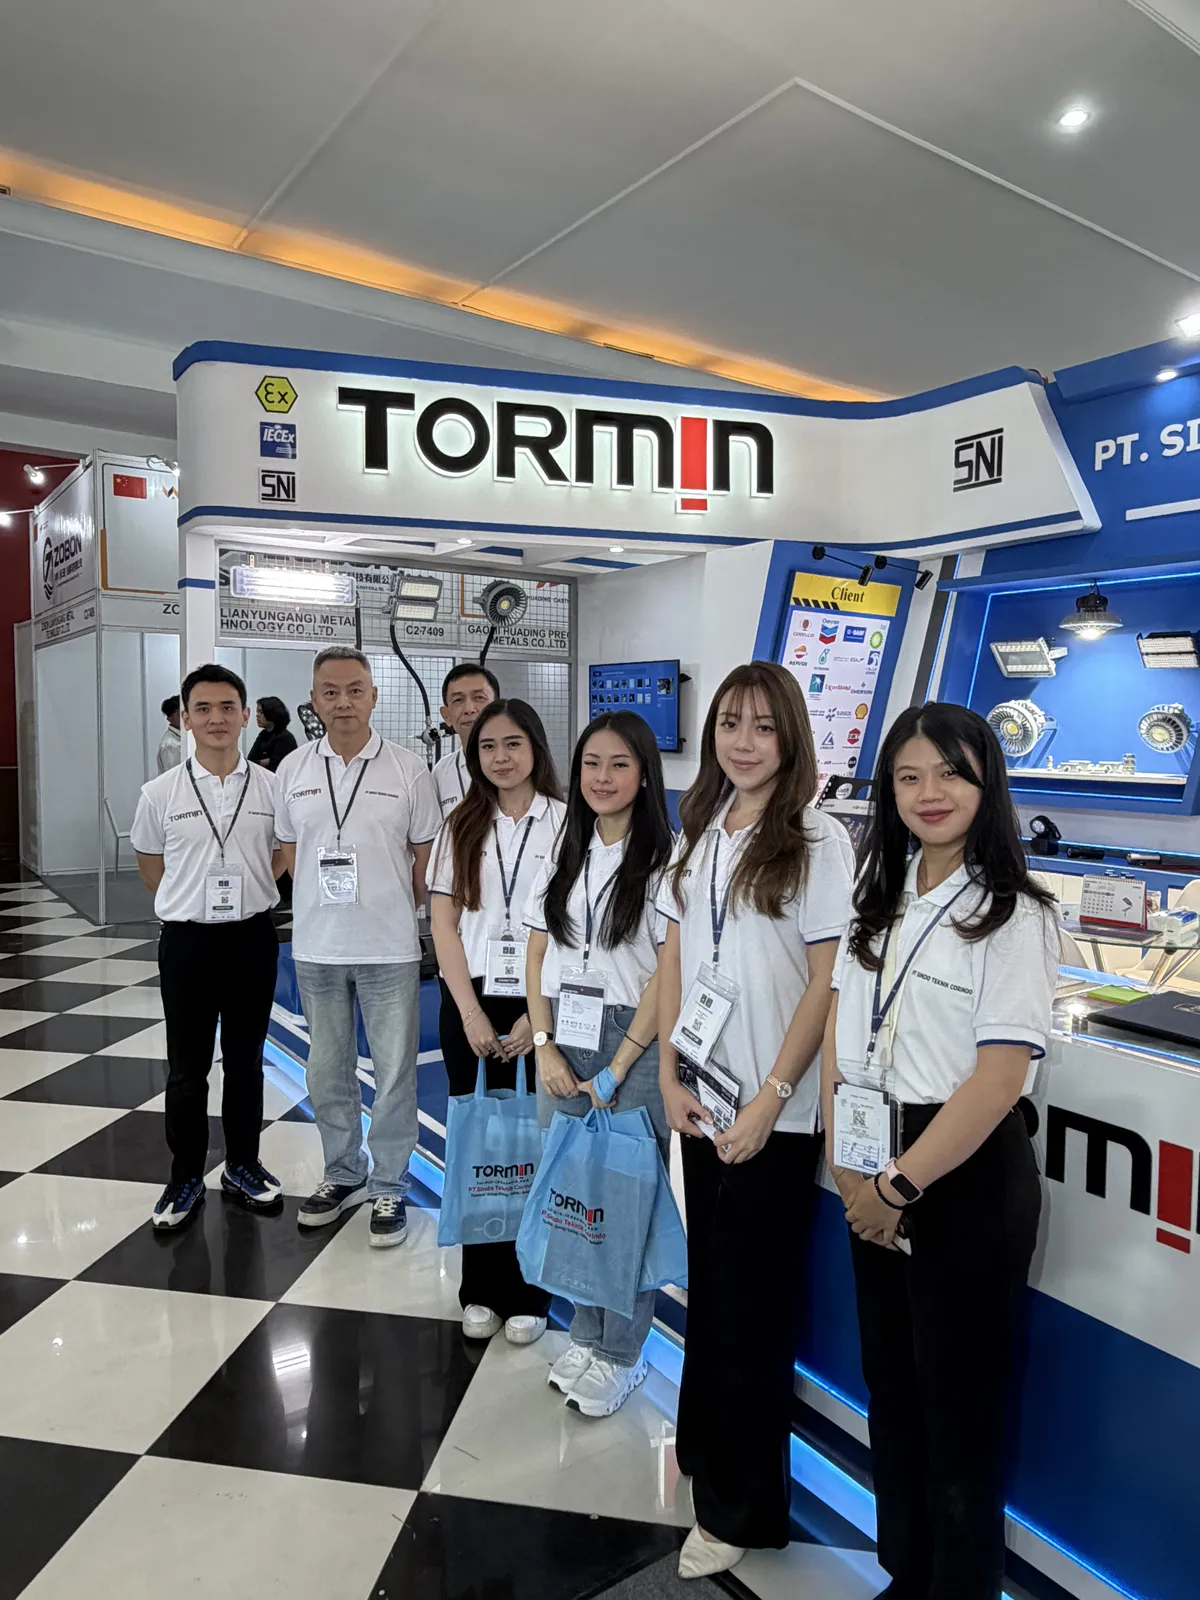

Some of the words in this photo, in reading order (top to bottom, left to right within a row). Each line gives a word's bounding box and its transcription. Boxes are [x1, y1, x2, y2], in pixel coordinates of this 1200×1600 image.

[264, 382, 289, 405] Ex
[263, 428, 295, 443] IECEx
[337, 386, 775, 512] TORMIN
[1094, 432, 1149, 472] PT.
[953, 434, 1004, 487] SNI
[261, 473, 296, 499] SNI
[831, 586, 865, 603] Client
[320, 614, 356, 627] METAL
[405, 624, 445, 637] C2-7409
[503, 627, 546, 639] HUADING
[168, 810, 203, 823] TORMIN
[472, 1162, 535, 1180] TORMIN
[549, 1187, 605, 1227] TORMIN
